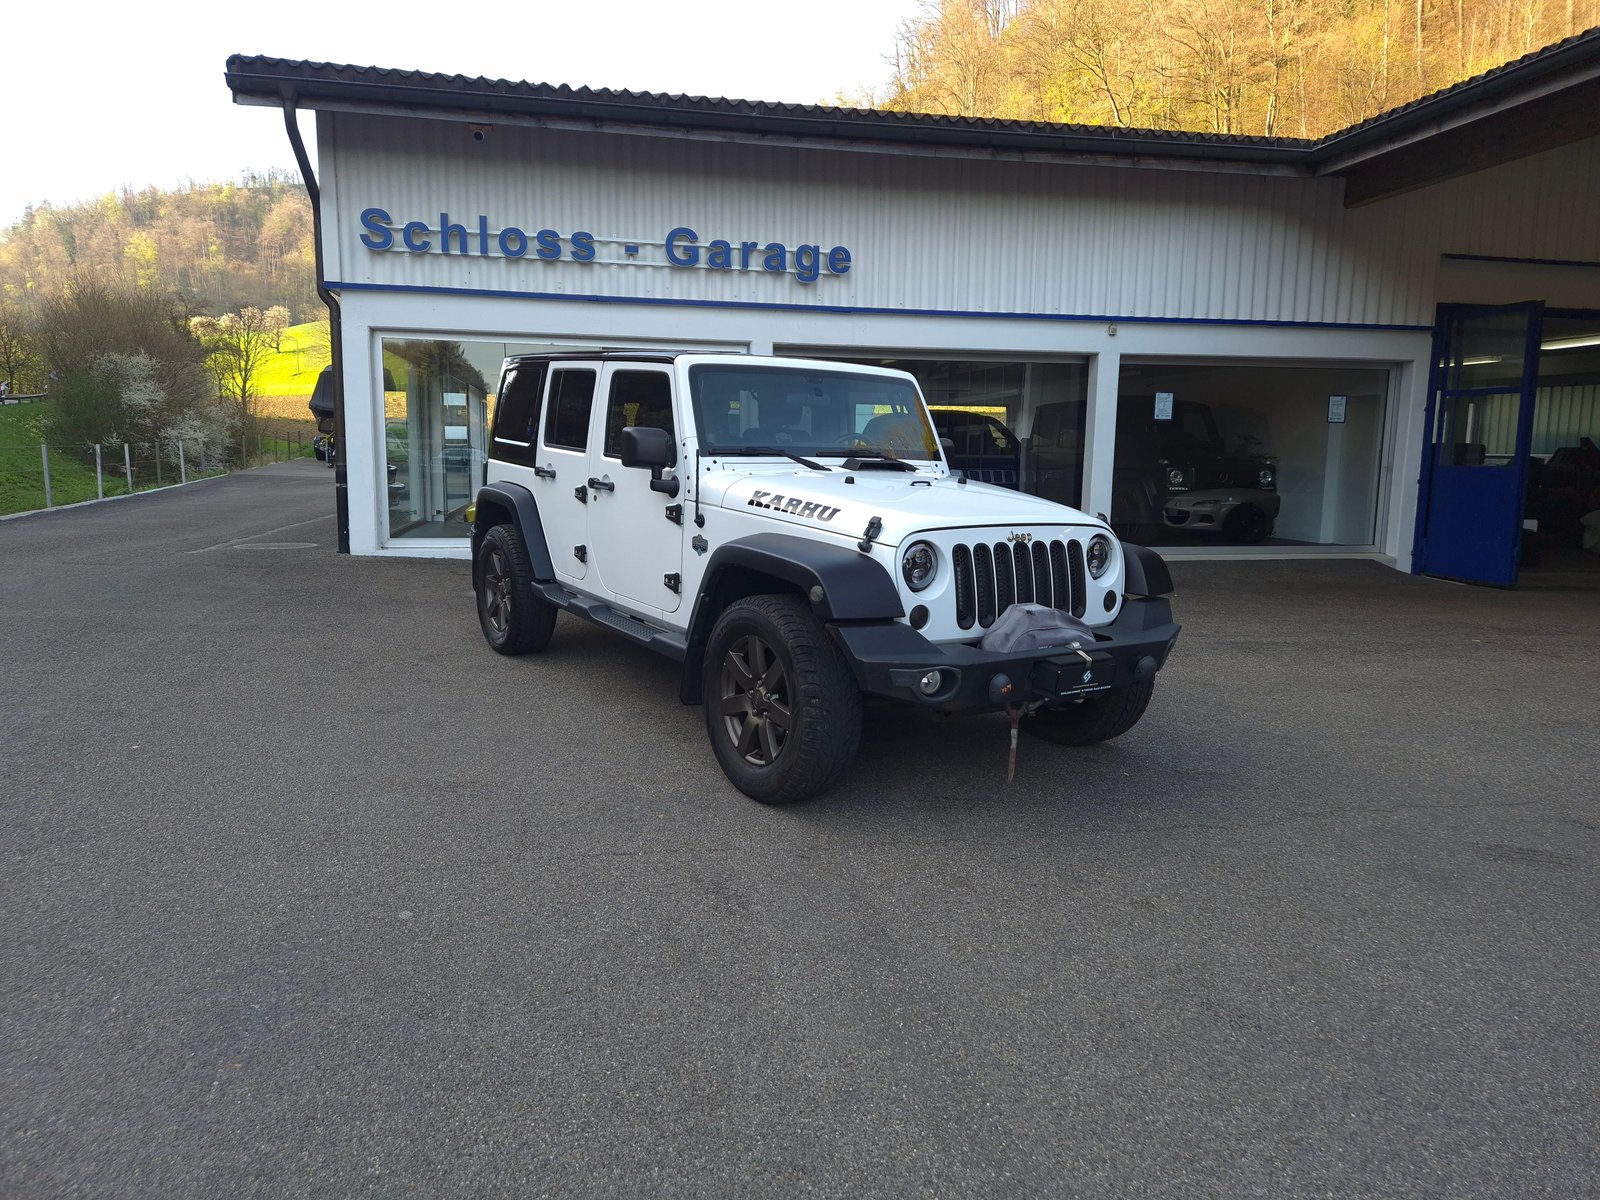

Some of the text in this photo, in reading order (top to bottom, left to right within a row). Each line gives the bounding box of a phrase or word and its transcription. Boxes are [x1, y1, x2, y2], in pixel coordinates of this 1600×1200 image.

[360, 208, 596, 263] Schloss
[665, 227, 852, 284] Garage
[748, 490, 841, 521] KARHU
[1007, 530, 1032, 543] Jeep
